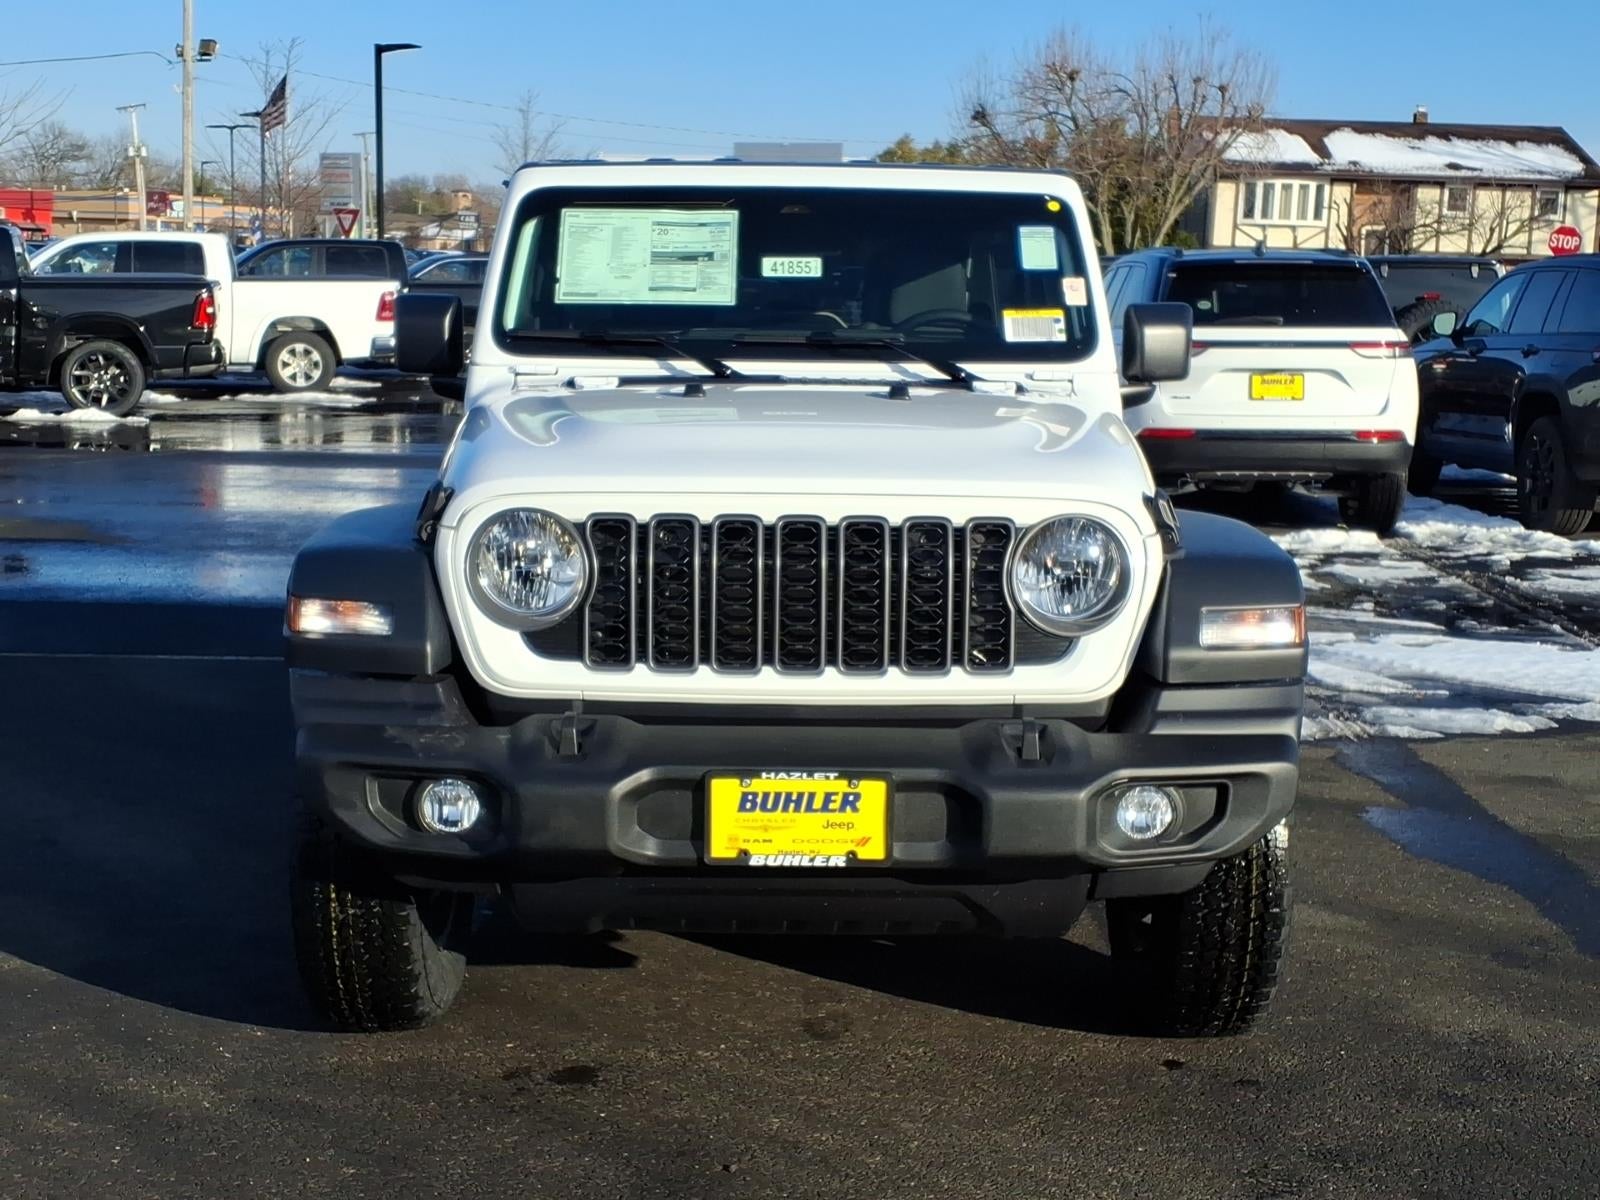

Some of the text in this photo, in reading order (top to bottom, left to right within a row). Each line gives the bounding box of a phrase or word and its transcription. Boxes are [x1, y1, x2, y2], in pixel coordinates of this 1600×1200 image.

[1550, 233, 1580, 250] STOP
[770, 260, 812, 275] 41855
[761, 771, 838, 781] HAZLET
[737, 791, 861, 813] BUHLER
[822, 819, 855, 831] Jeep
[749, 855, 847, 867] BUHLER
